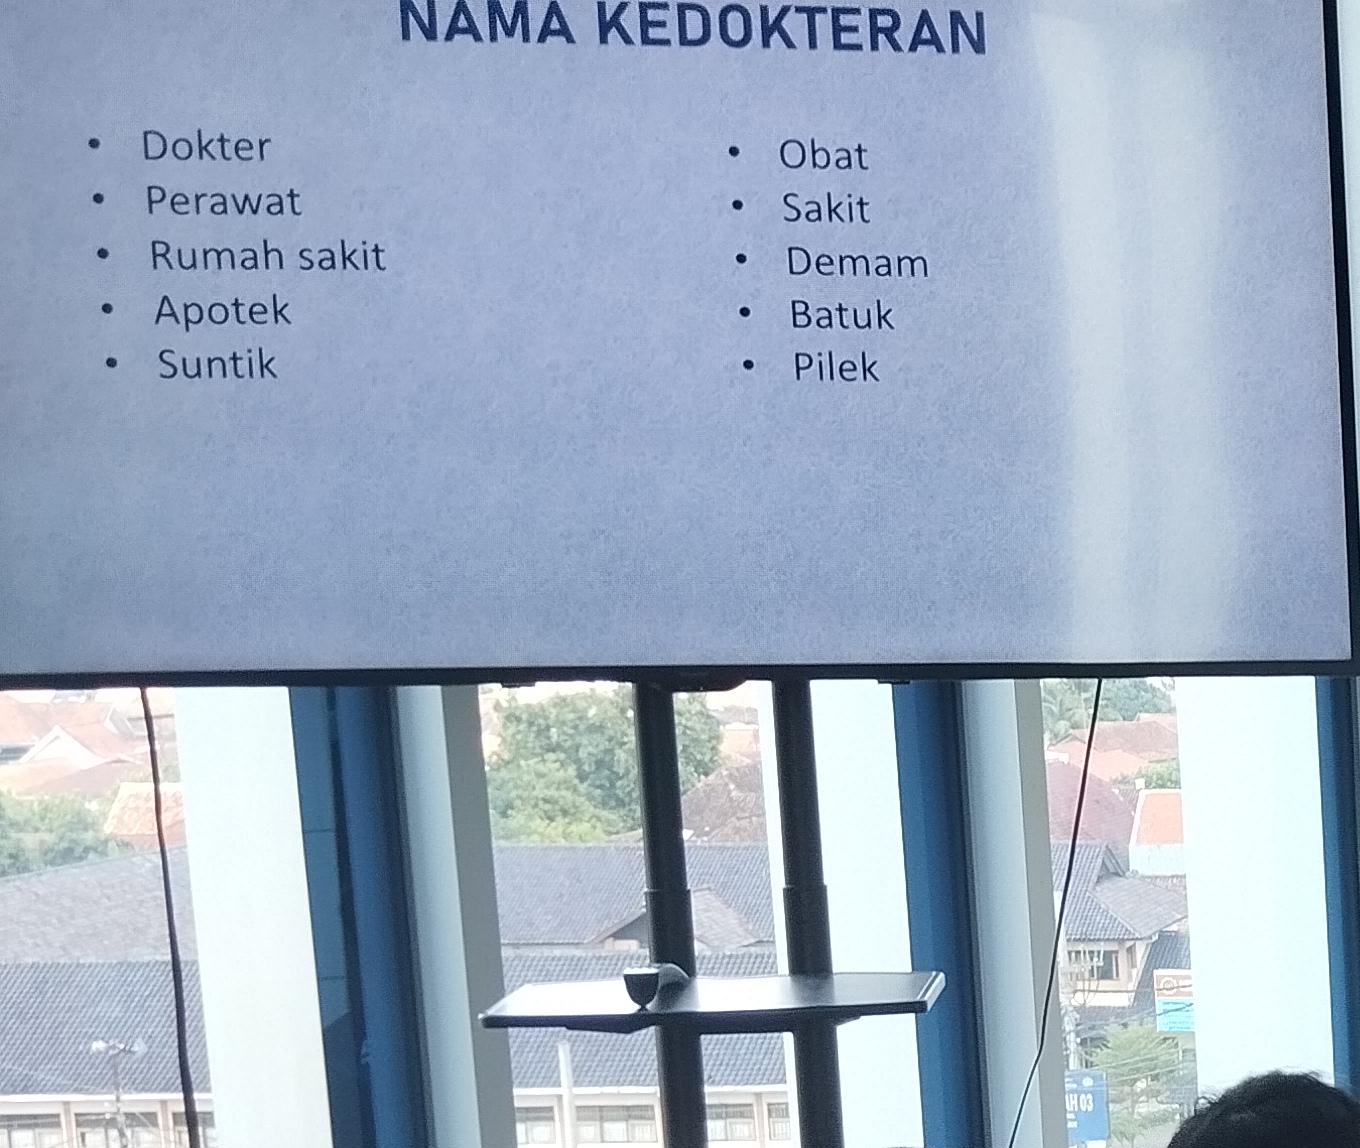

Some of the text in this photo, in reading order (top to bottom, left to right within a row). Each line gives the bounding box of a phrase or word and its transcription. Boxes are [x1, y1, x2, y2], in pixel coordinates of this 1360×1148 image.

[399, 0, 987, 55] NAMA KEDOKTERAN
[142, 128, 272, 162] Dokter
[779, 138, 870, 171] Obat
[147, 185, 303, 217] Perawat
[782, 192, 871, 225] Sakit
[150, 239, 387, 272] Rumah sakit
[787, 245, 929, 278] Demam
[154, 293, 292, 333] Apotek
[791, 298, 895, 331] Batuk
[158, 347, 278, 380] Suntik
[794, 350, 880, 383] Pilek
[1079, 1093, 1094, 1112] 03
